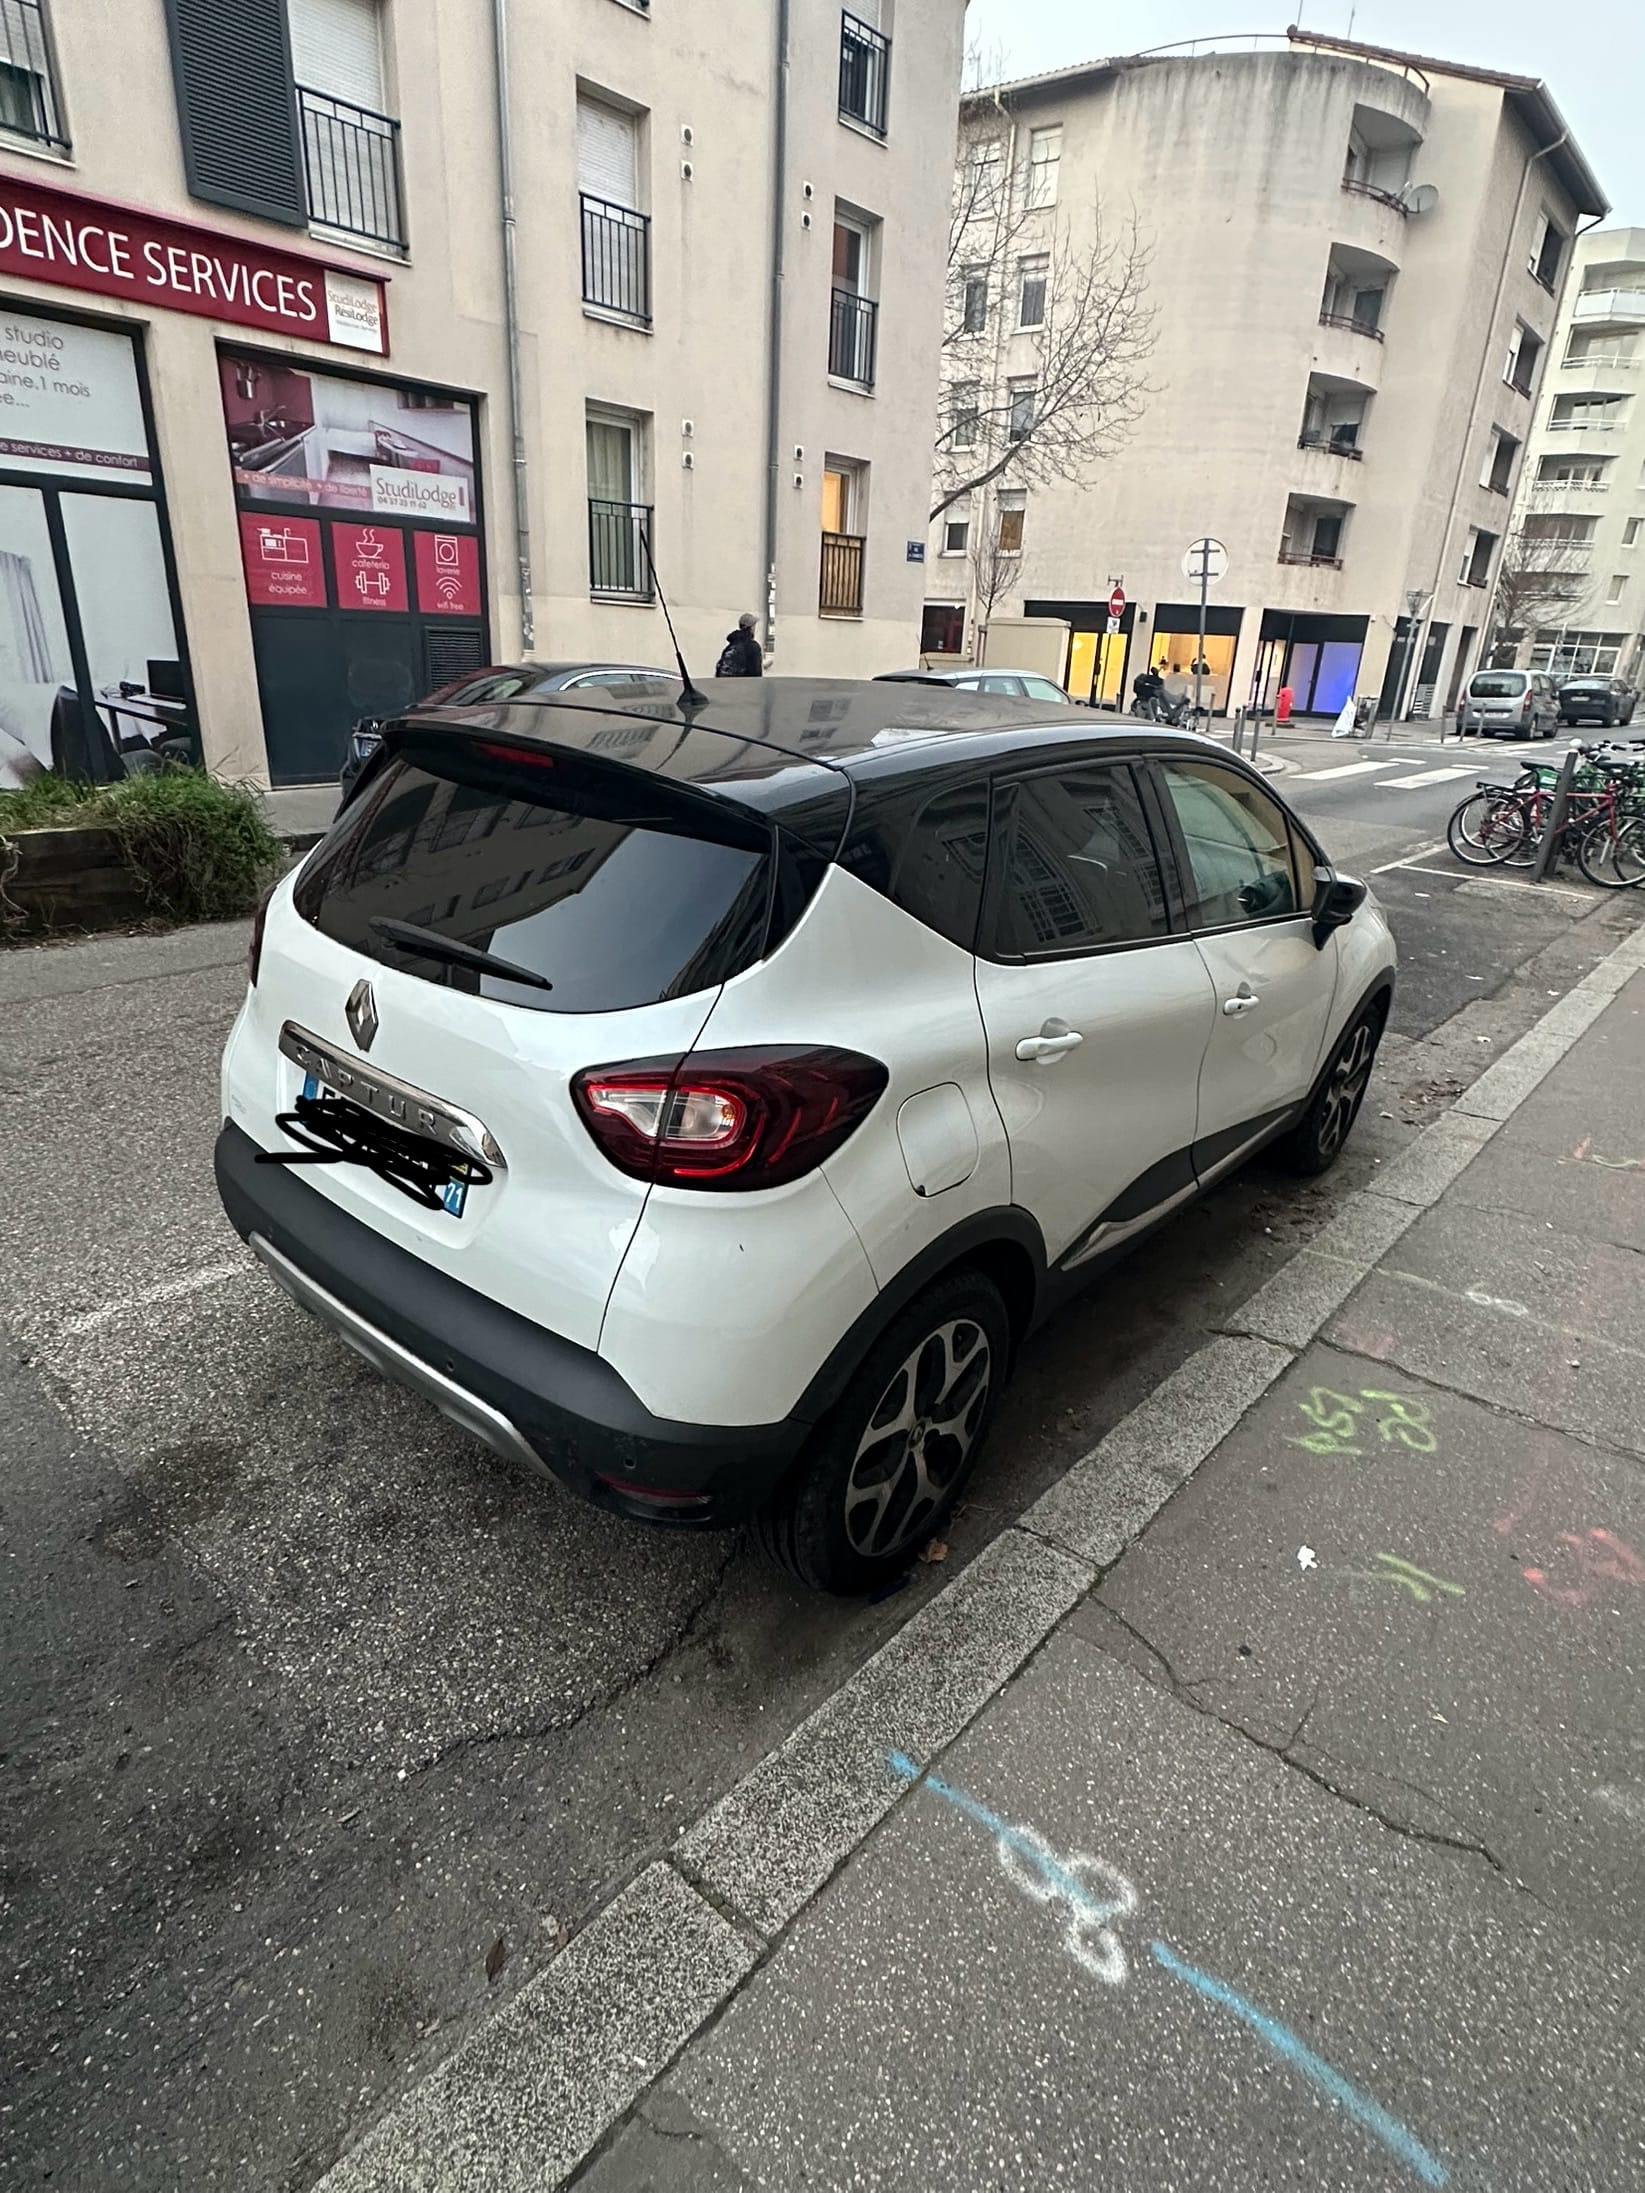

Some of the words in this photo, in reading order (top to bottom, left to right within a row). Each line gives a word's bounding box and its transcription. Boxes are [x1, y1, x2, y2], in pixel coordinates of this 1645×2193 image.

[143, 241, 316, 321] SERVICES
[5, 325, 64, 350] studio
[0, 349, 60, 371] eublé
[54, 380, 90, 398] mois
[11, 442, 61, 458] services
[76, 450, 92, 462] de
[96, 454, 138, 467] confort
[376, 477, 456, 508] StudiLodge
[271, 571, 302, 581] cuisine
[296, 1043, 438, 1136] CAPTUR
